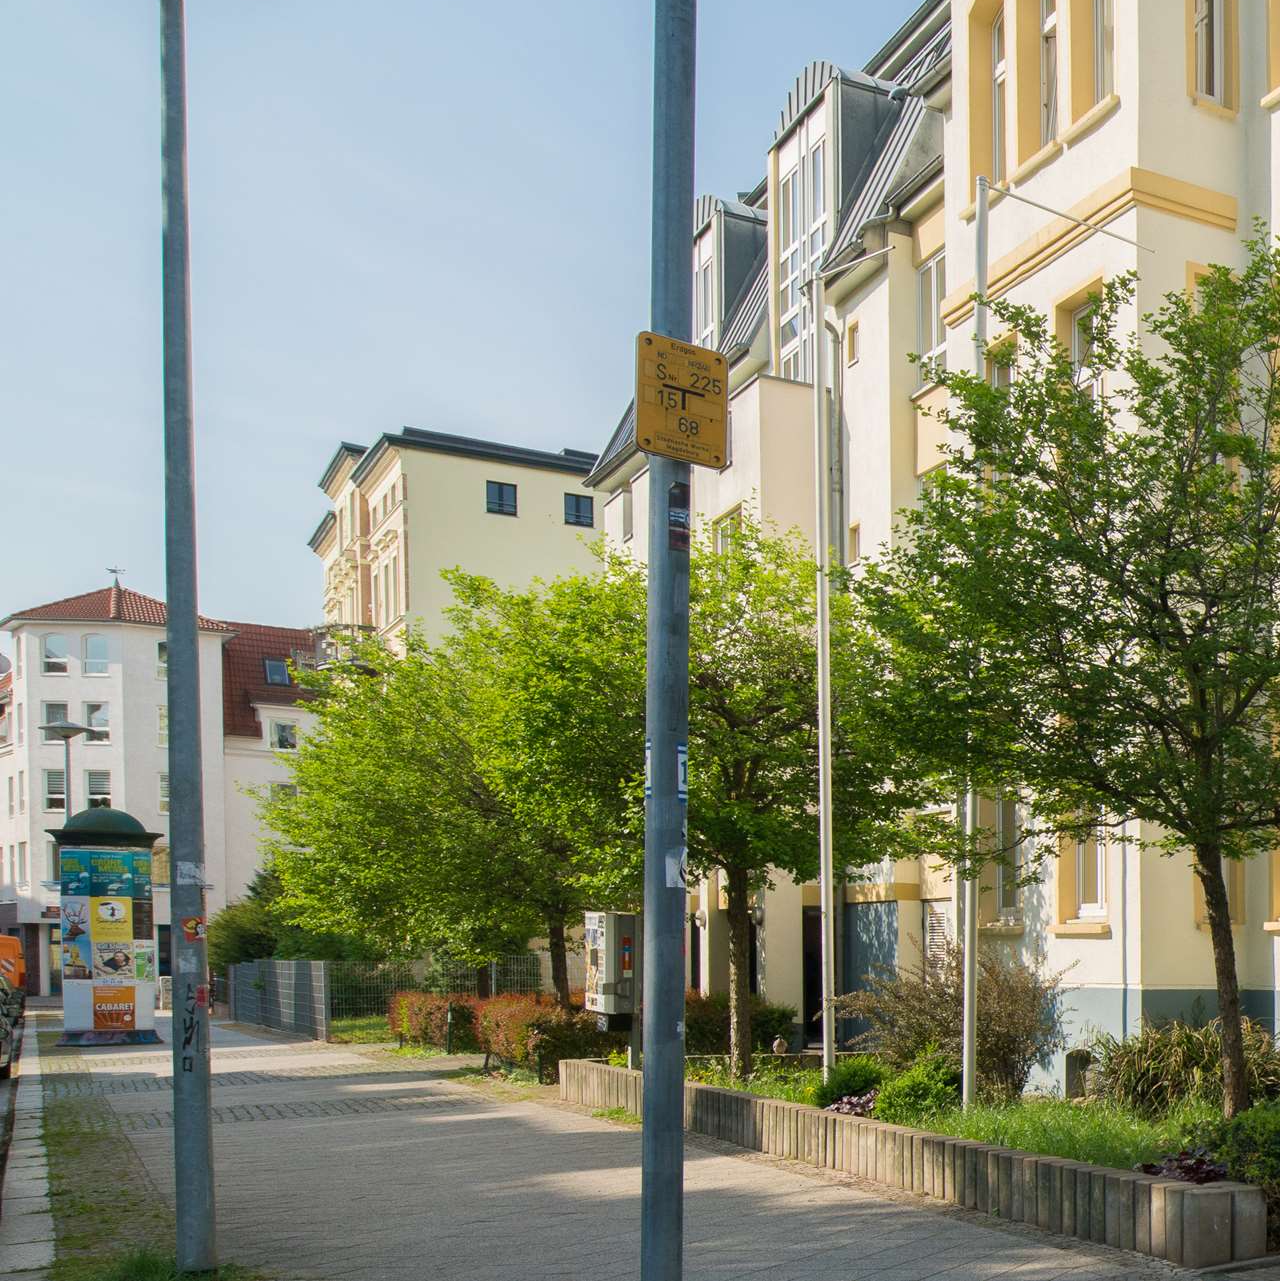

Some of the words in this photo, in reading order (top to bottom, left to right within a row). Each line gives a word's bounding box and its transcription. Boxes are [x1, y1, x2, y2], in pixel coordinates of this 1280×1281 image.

[656, 363, 667, 381] S
[689, 373, 722, 395] 225
[95, 1002, 134, 1012] CABARET
